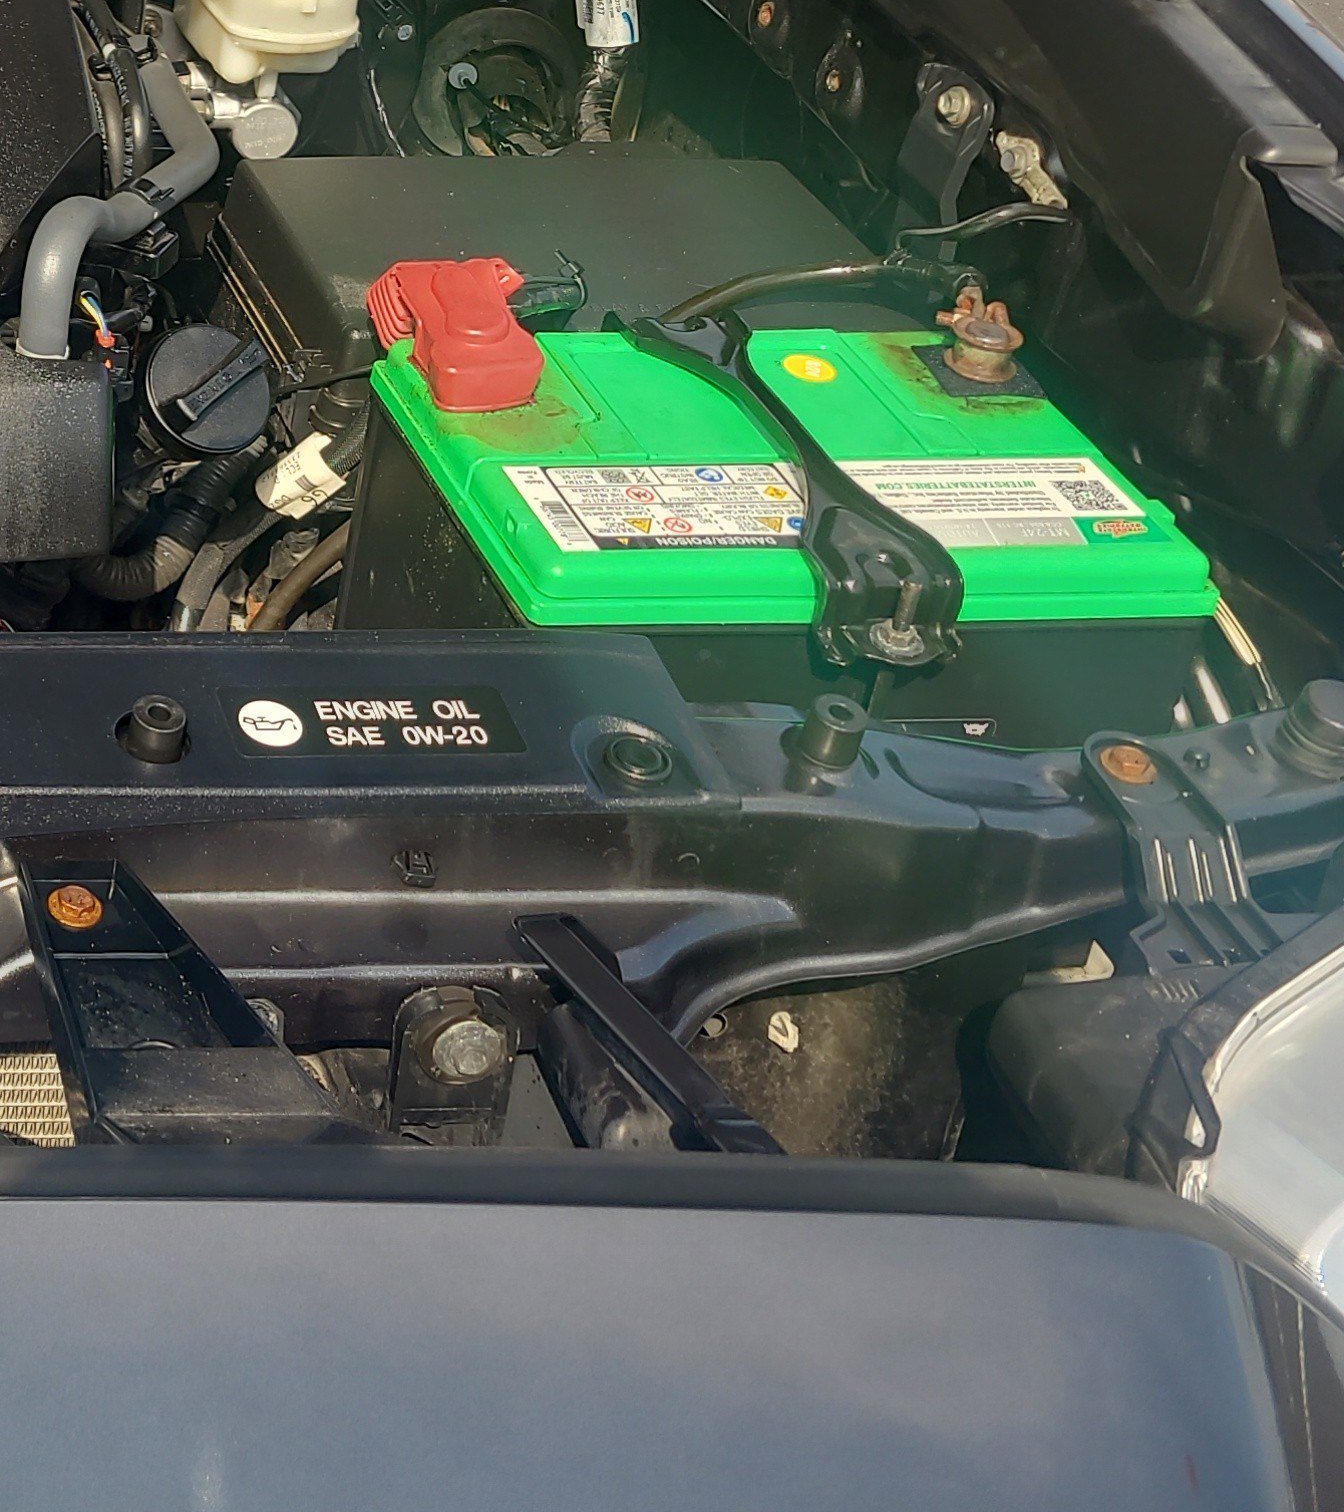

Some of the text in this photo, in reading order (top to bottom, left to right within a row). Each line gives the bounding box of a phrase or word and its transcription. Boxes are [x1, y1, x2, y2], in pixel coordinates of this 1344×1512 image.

[875, 480, 1036, 490] INTERSTATEBATTERIES.COM
[655, 536, 777, 546] DANGER/POISON
[313, 699, 481, 721] ENGINE OIL
[326, 725, 489, 747] SAE 0W-20
